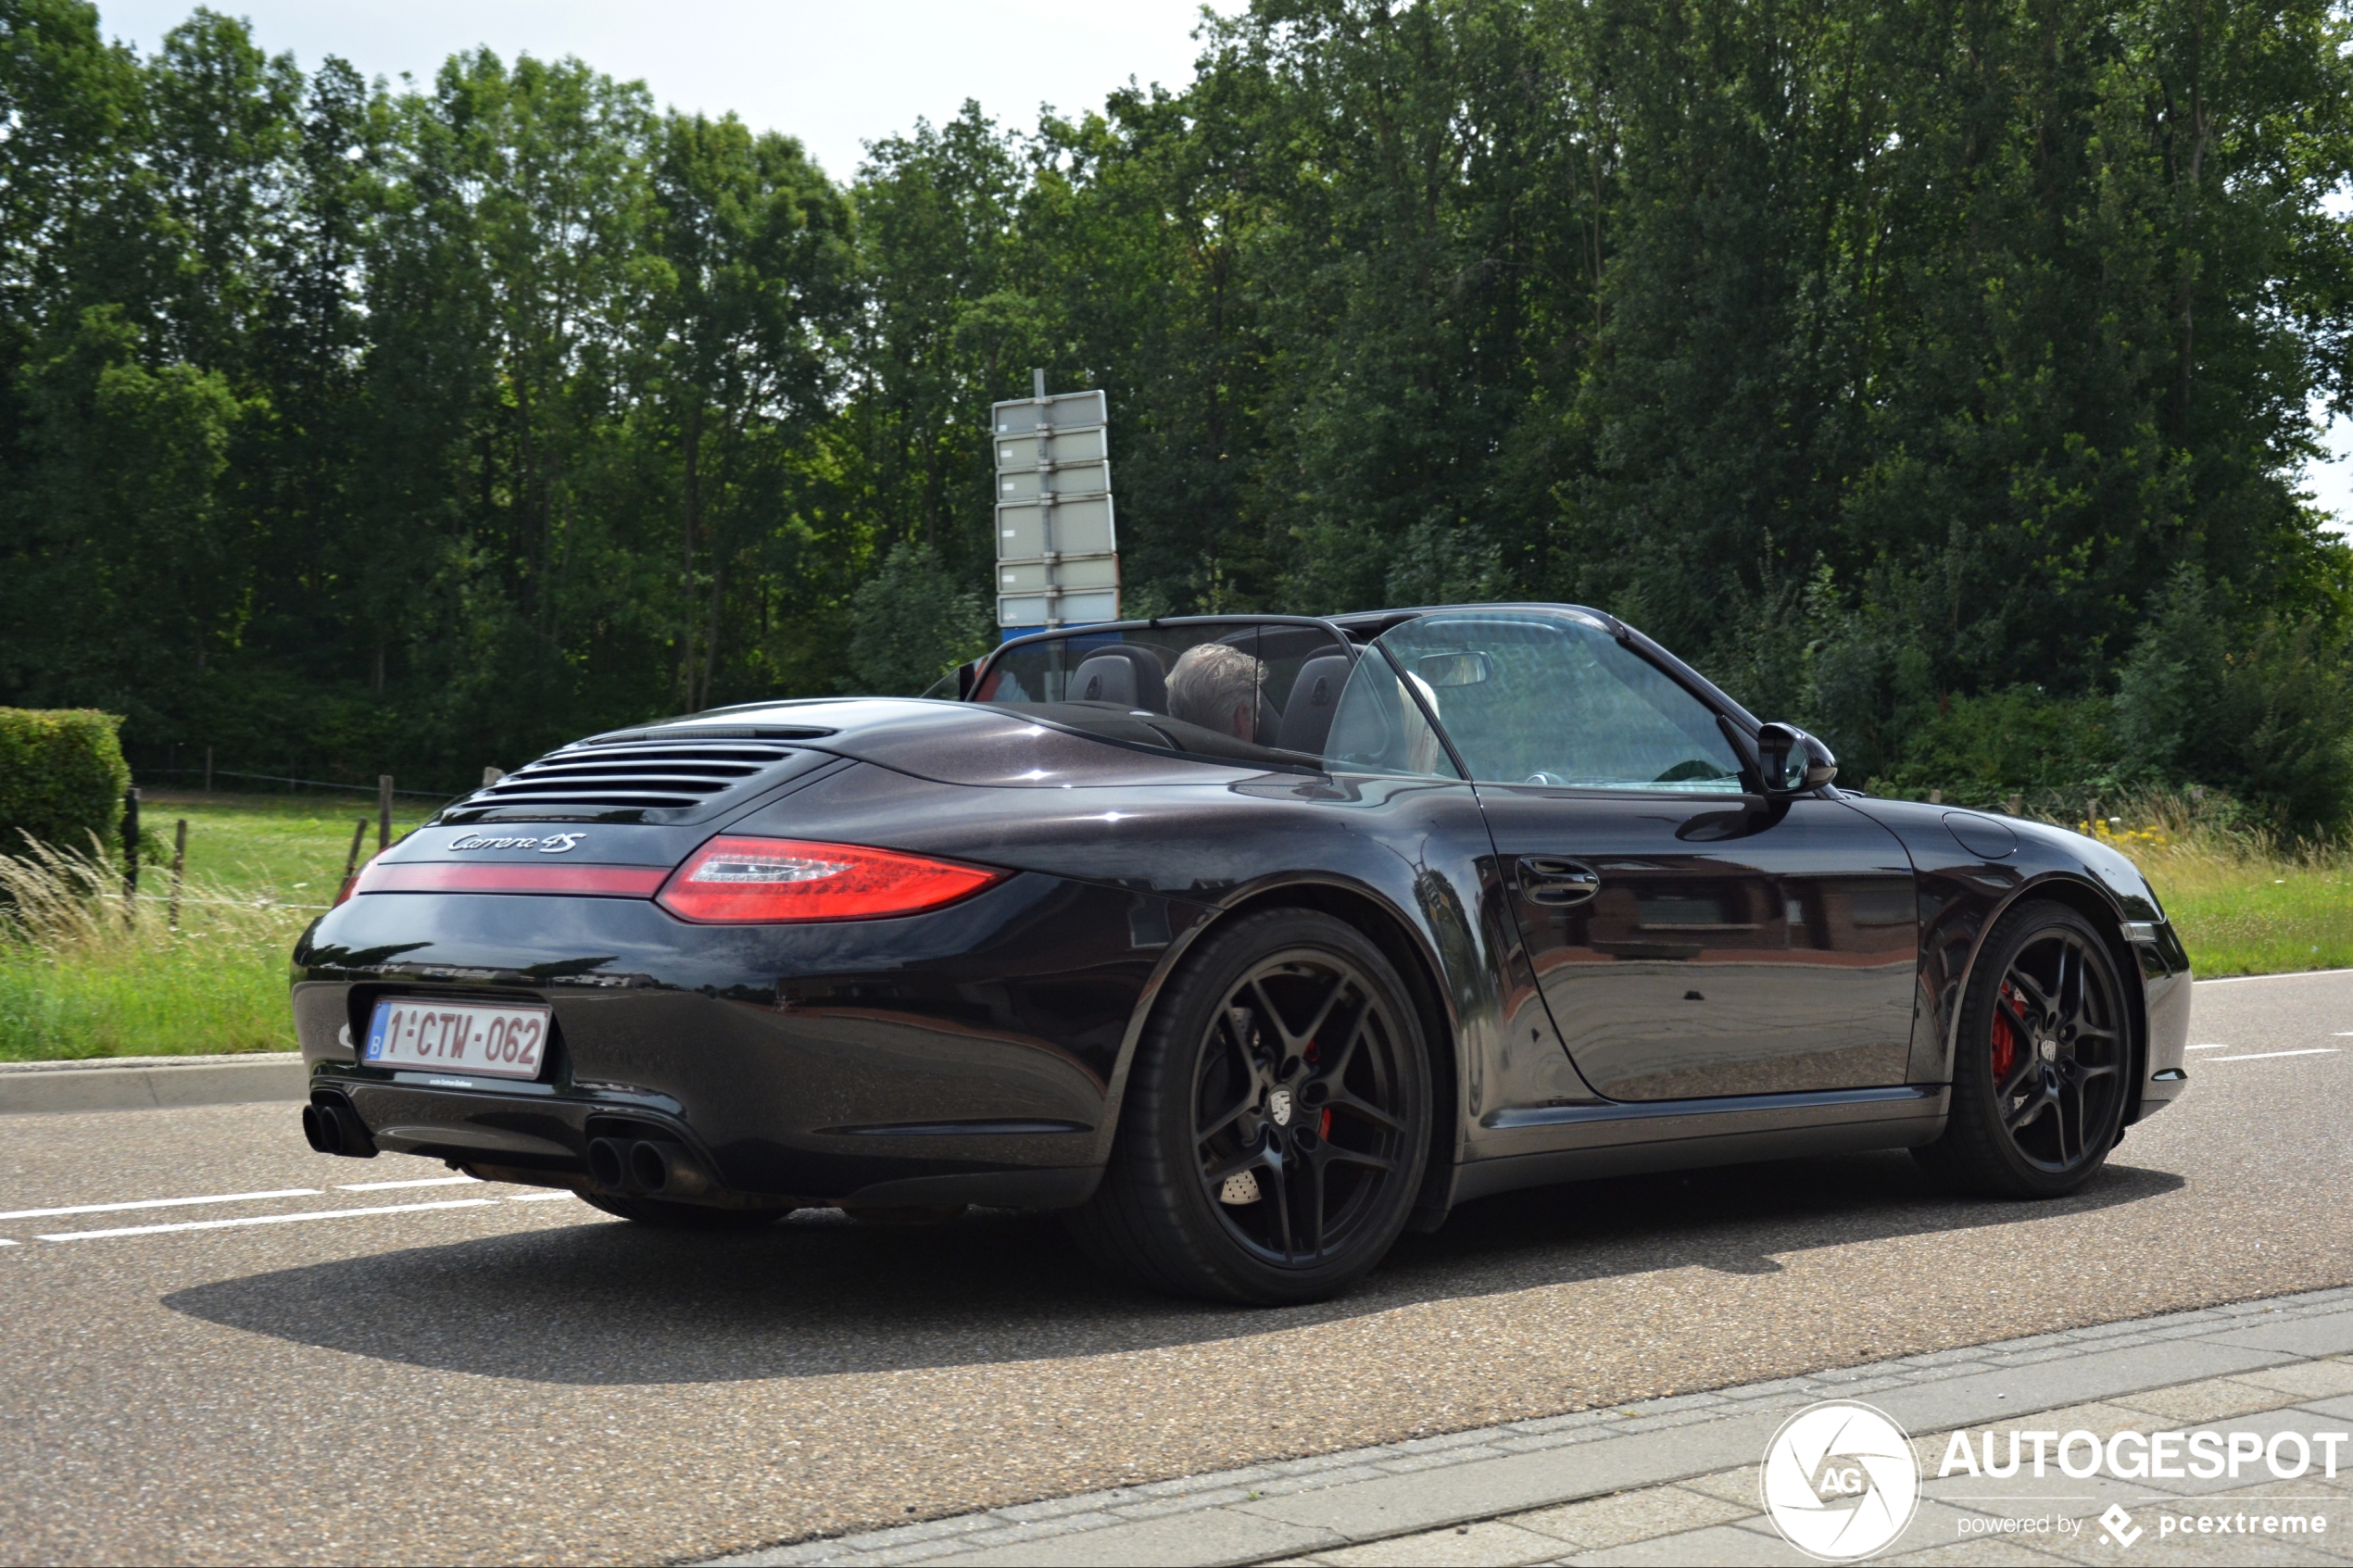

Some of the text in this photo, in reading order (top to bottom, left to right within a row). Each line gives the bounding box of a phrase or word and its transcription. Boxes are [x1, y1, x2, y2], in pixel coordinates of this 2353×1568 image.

[447, 832, 587, 853] Carrera 4S
[370, 1035, 381, 1055] B
[389, 1010, 541, 1065] 1-CTW-062
